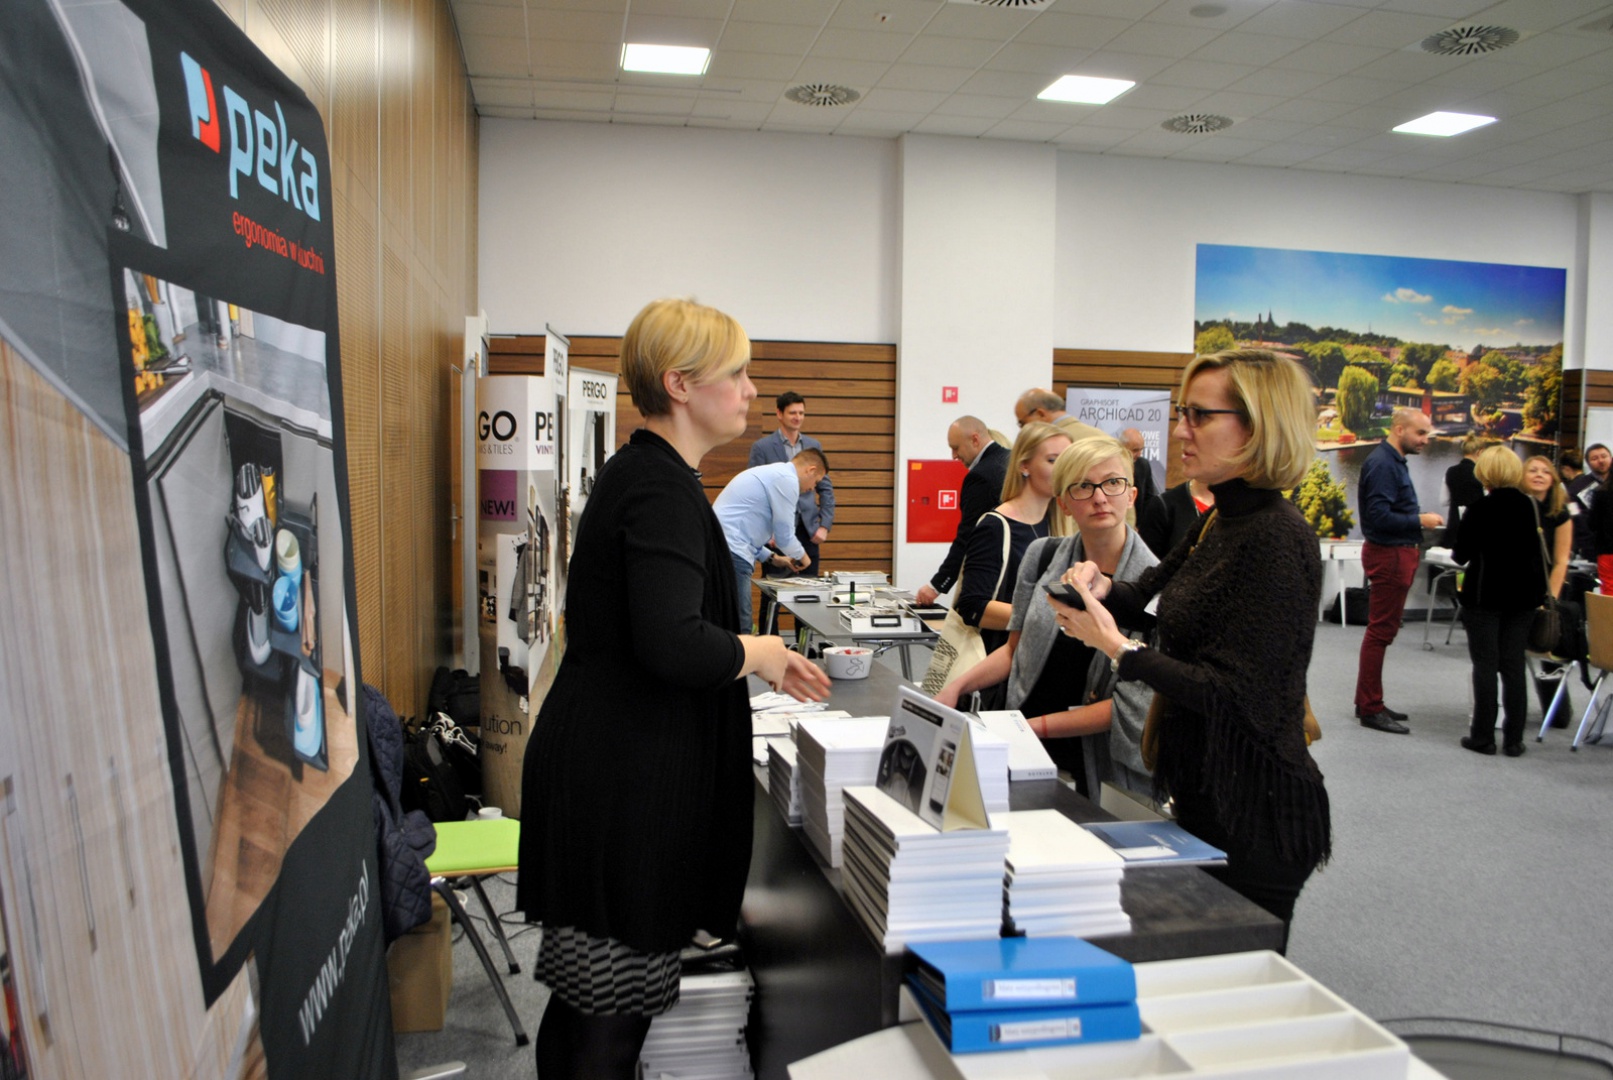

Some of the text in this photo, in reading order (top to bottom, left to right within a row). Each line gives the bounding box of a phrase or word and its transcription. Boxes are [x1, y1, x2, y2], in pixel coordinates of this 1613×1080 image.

[223, 85, 320, 222] peka
[232, 211, 289, 258] ergonomia
[582, 380, 607, 399] PERGO
[1079, 407, 1161, 421] ARCHICAD 20
[493, 444, 514, 455] TILES
[481, 500, 515, 516] NEW!
